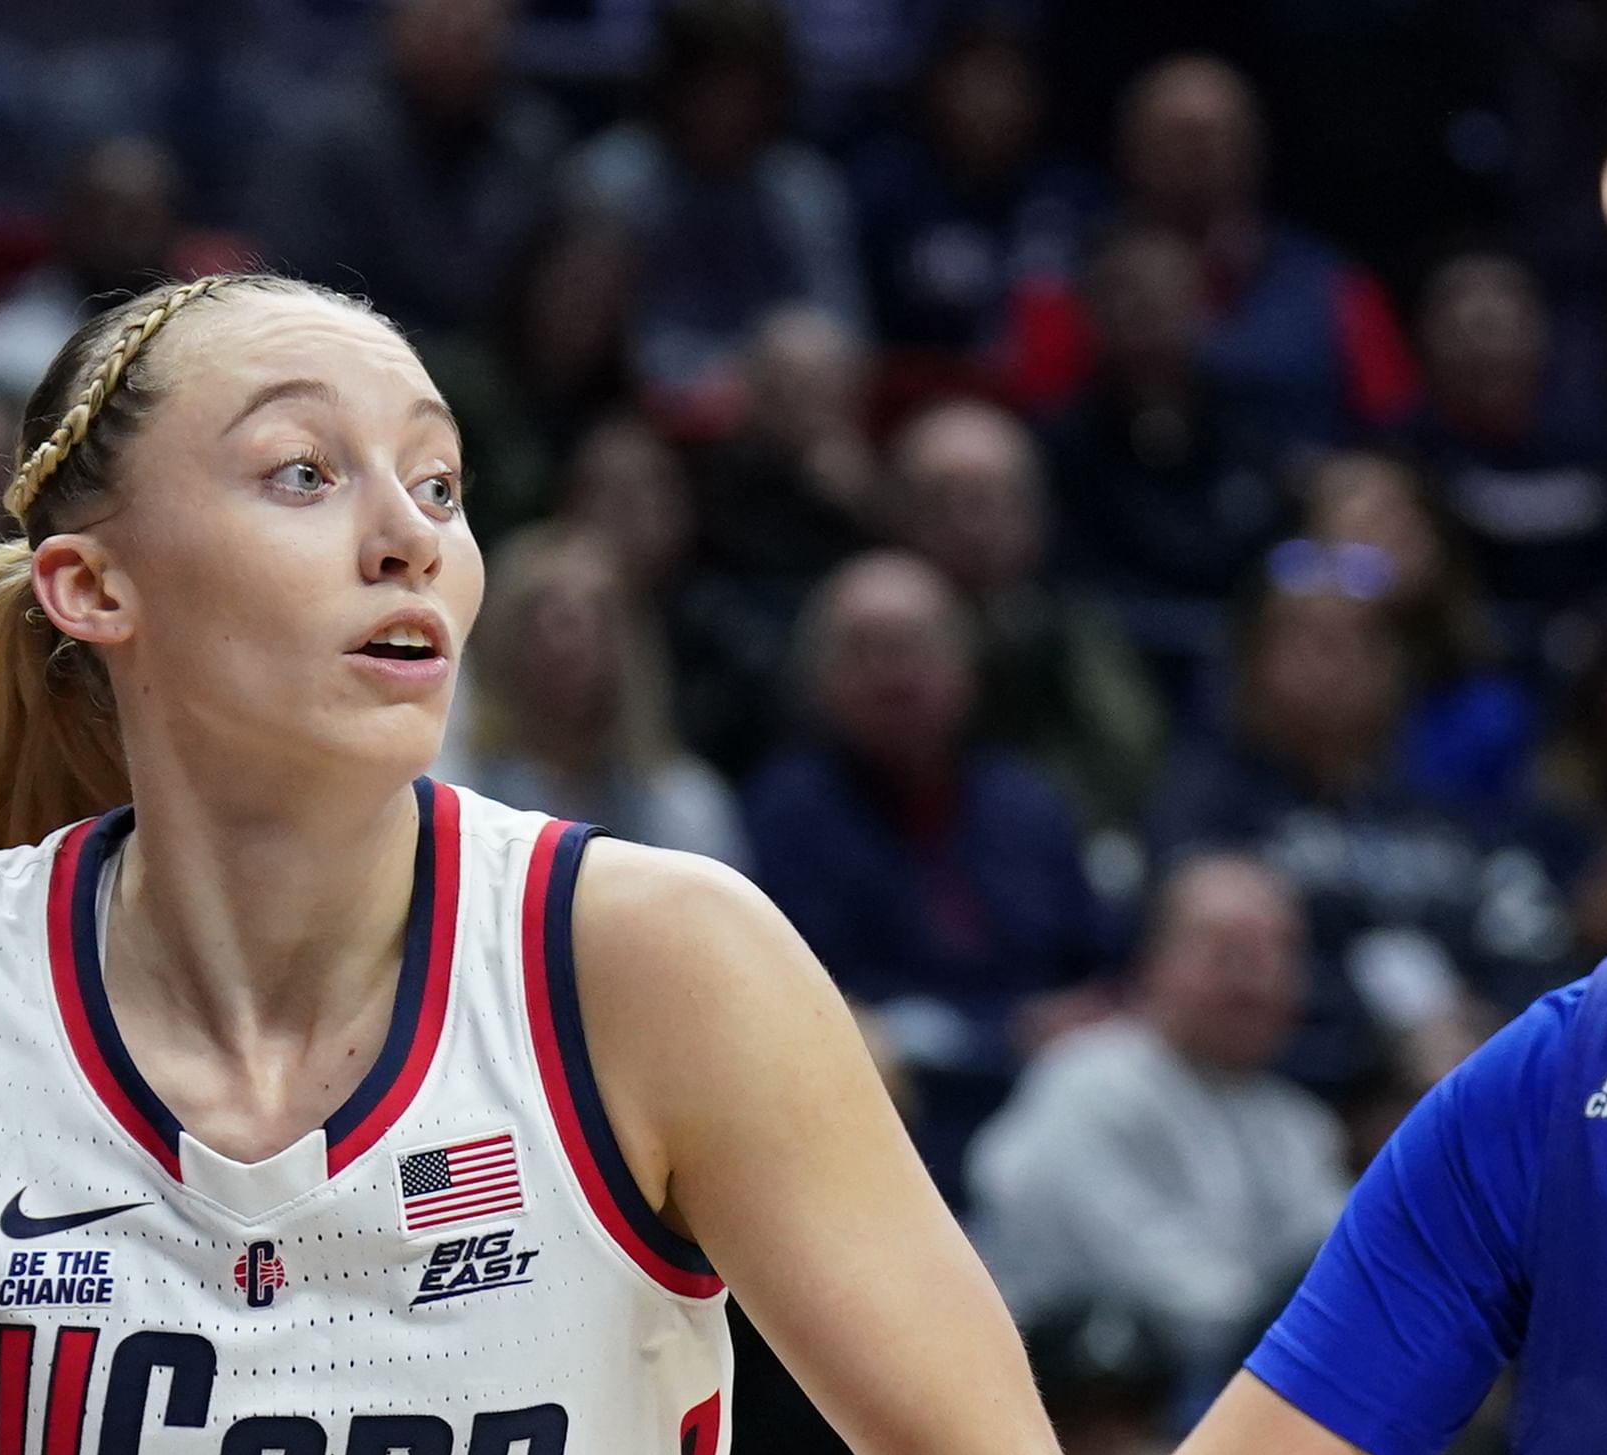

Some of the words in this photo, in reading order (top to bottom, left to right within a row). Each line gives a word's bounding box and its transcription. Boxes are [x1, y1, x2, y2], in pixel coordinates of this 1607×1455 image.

[9, 1253, 47, 1276] BE
[56, 1251, 109, 1275] THE
[429, 1230, 517, 1268] BIG
[420, 1250, 540, 1292] EAST
